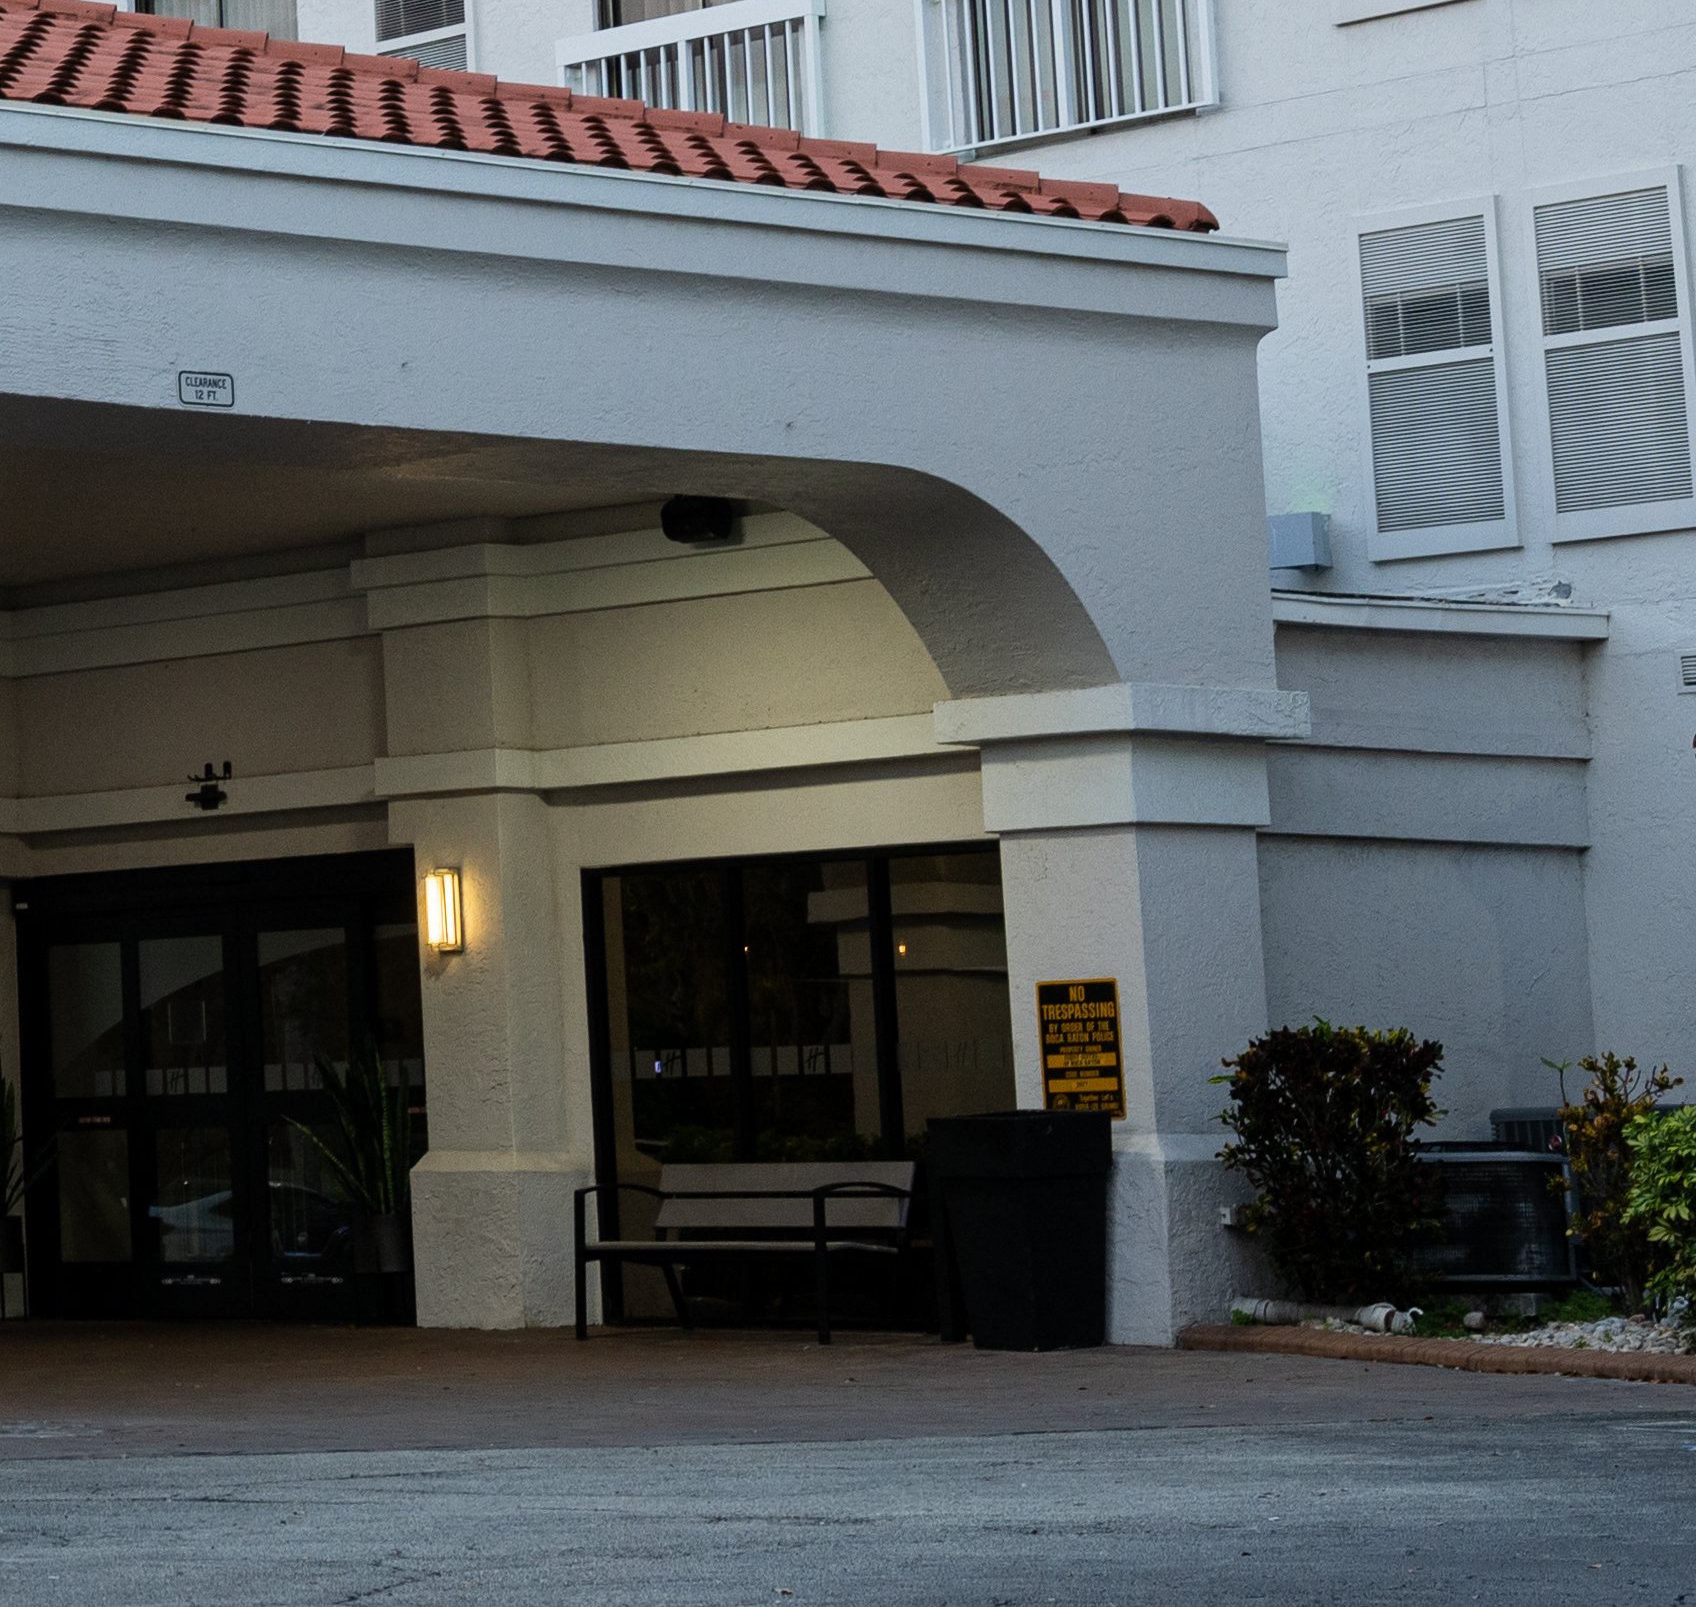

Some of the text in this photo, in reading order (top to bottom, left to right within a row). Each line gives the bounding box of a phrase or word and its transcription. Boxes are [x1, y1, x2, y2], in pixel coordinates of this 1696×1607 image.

[185, 376, 227, 389] CLEARANCE
[195, 389, 204, 400] 12
[1068, 985, 1086, 1002] NO
[1041, 1002, 1115, 1021] TRESPASSING
[1048, 1020, 1110, 1033] BY ORDER OF THE
[1045, 1030, 1115, 1044] BOCA RATON POLICE
